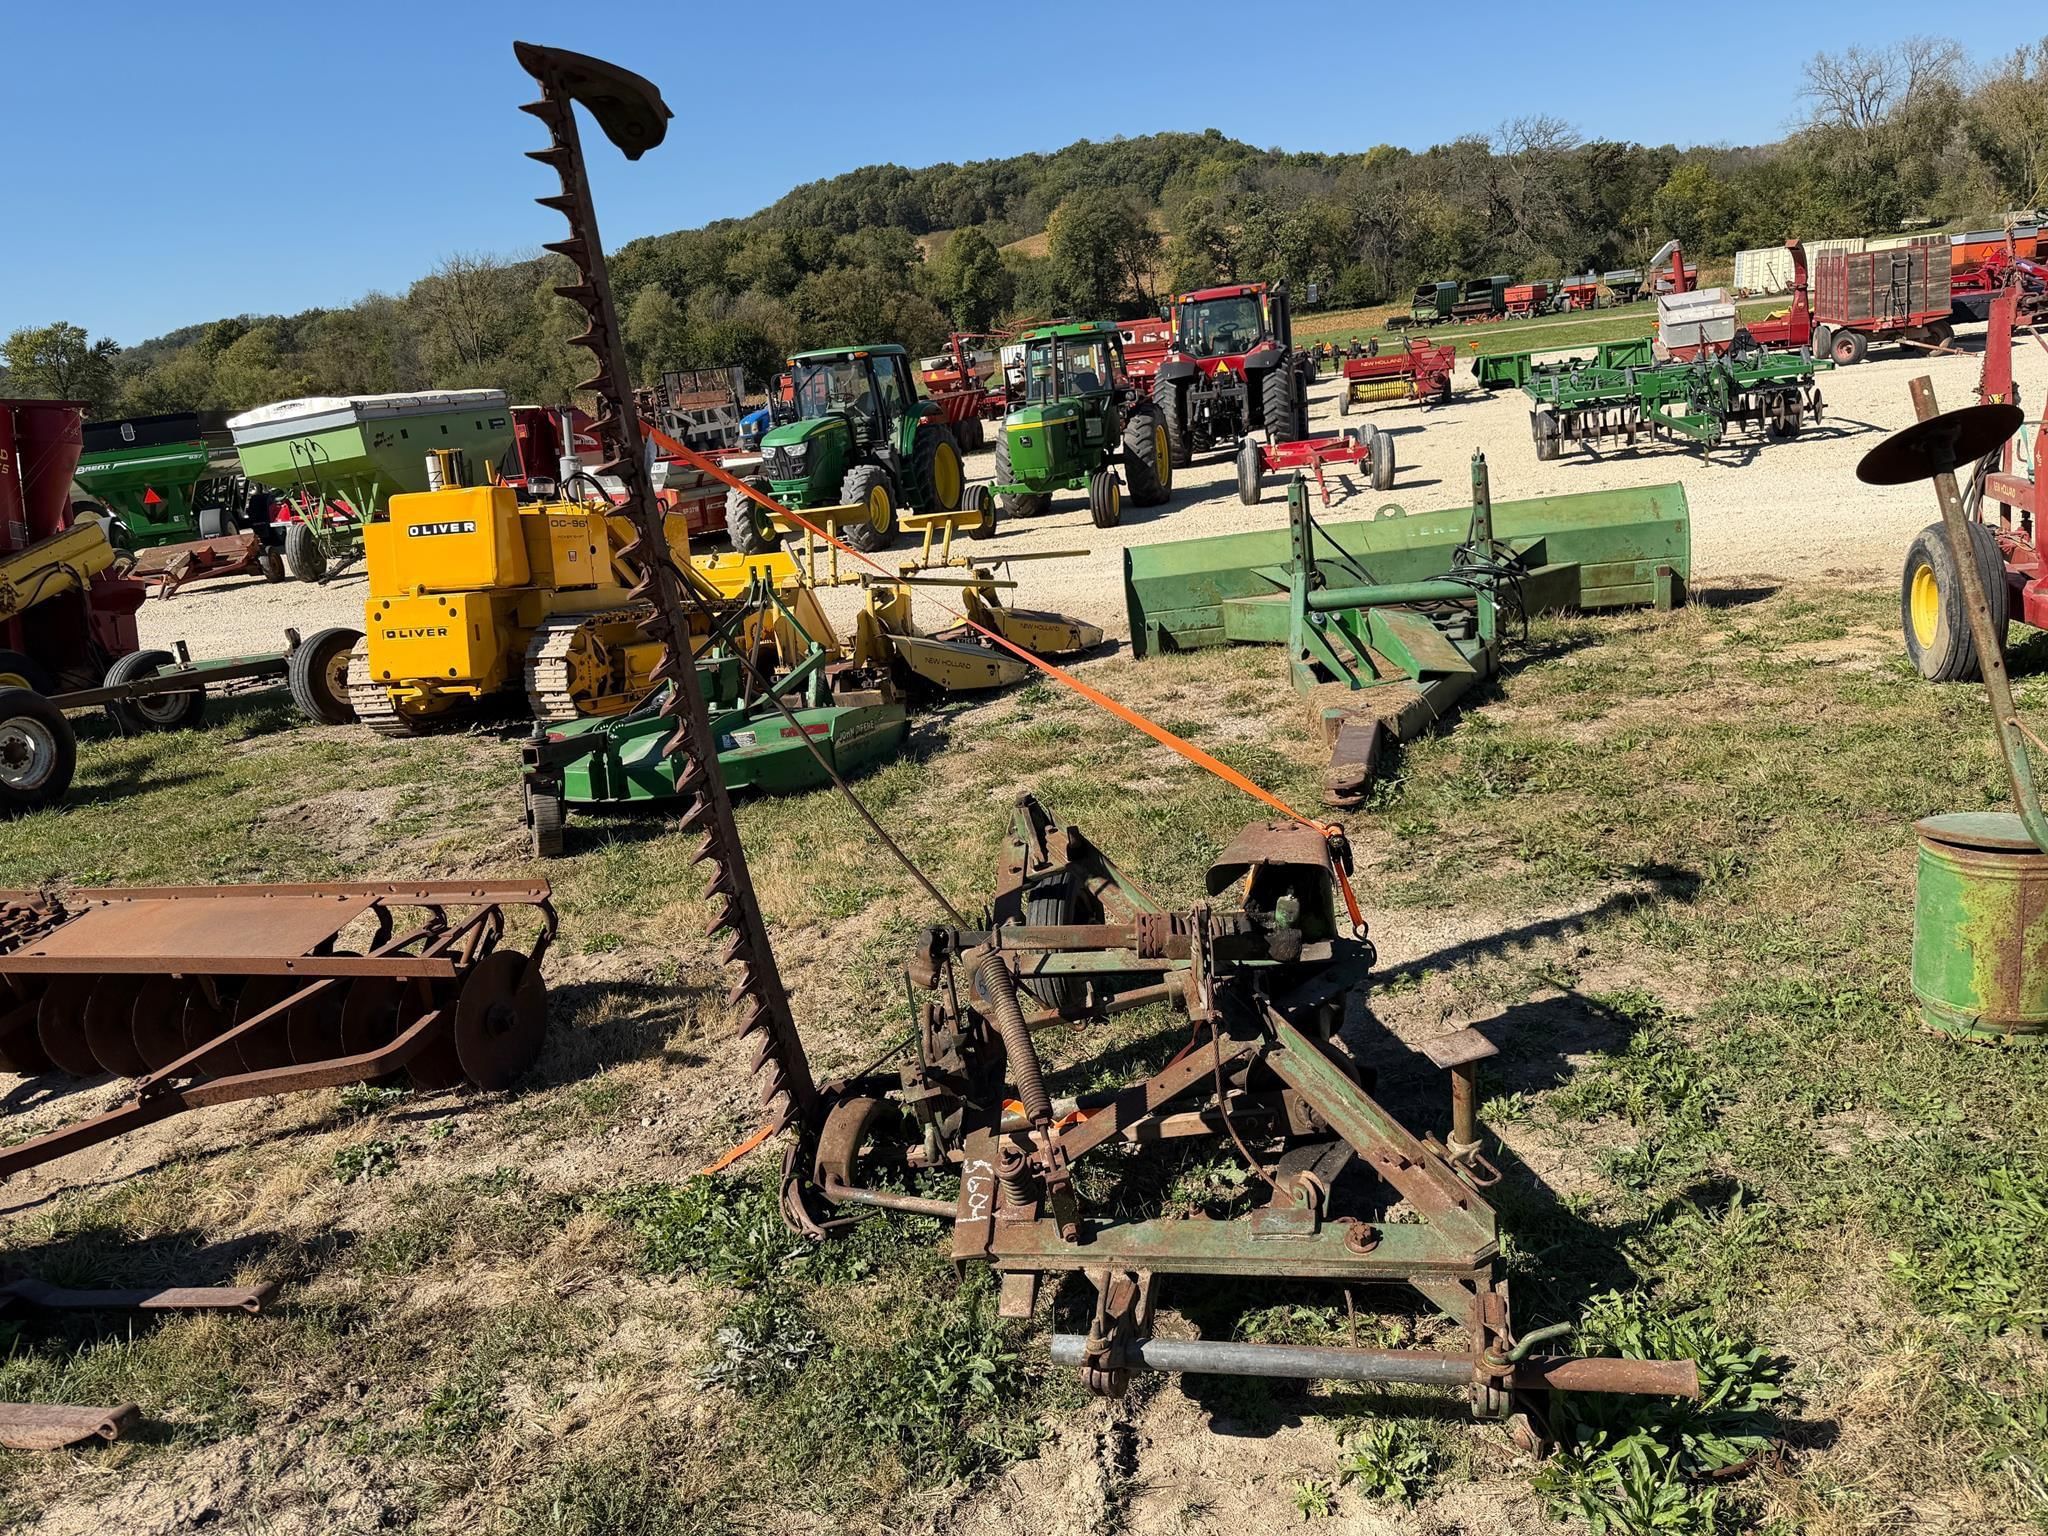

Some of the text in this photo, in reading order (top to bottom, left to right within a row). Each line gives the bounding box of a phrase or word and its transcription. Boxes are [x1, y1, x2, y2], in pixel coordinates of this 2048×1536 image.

[1375, 357, 1402, 366] HOLLAND
[409, 521, 475, 536] OLIVER
[386, 628, 447, 639] OLIVER
[1034, 624, 1060, 632] HOLLAND
[925, 657, 971, 670] NEW HOLLAND
